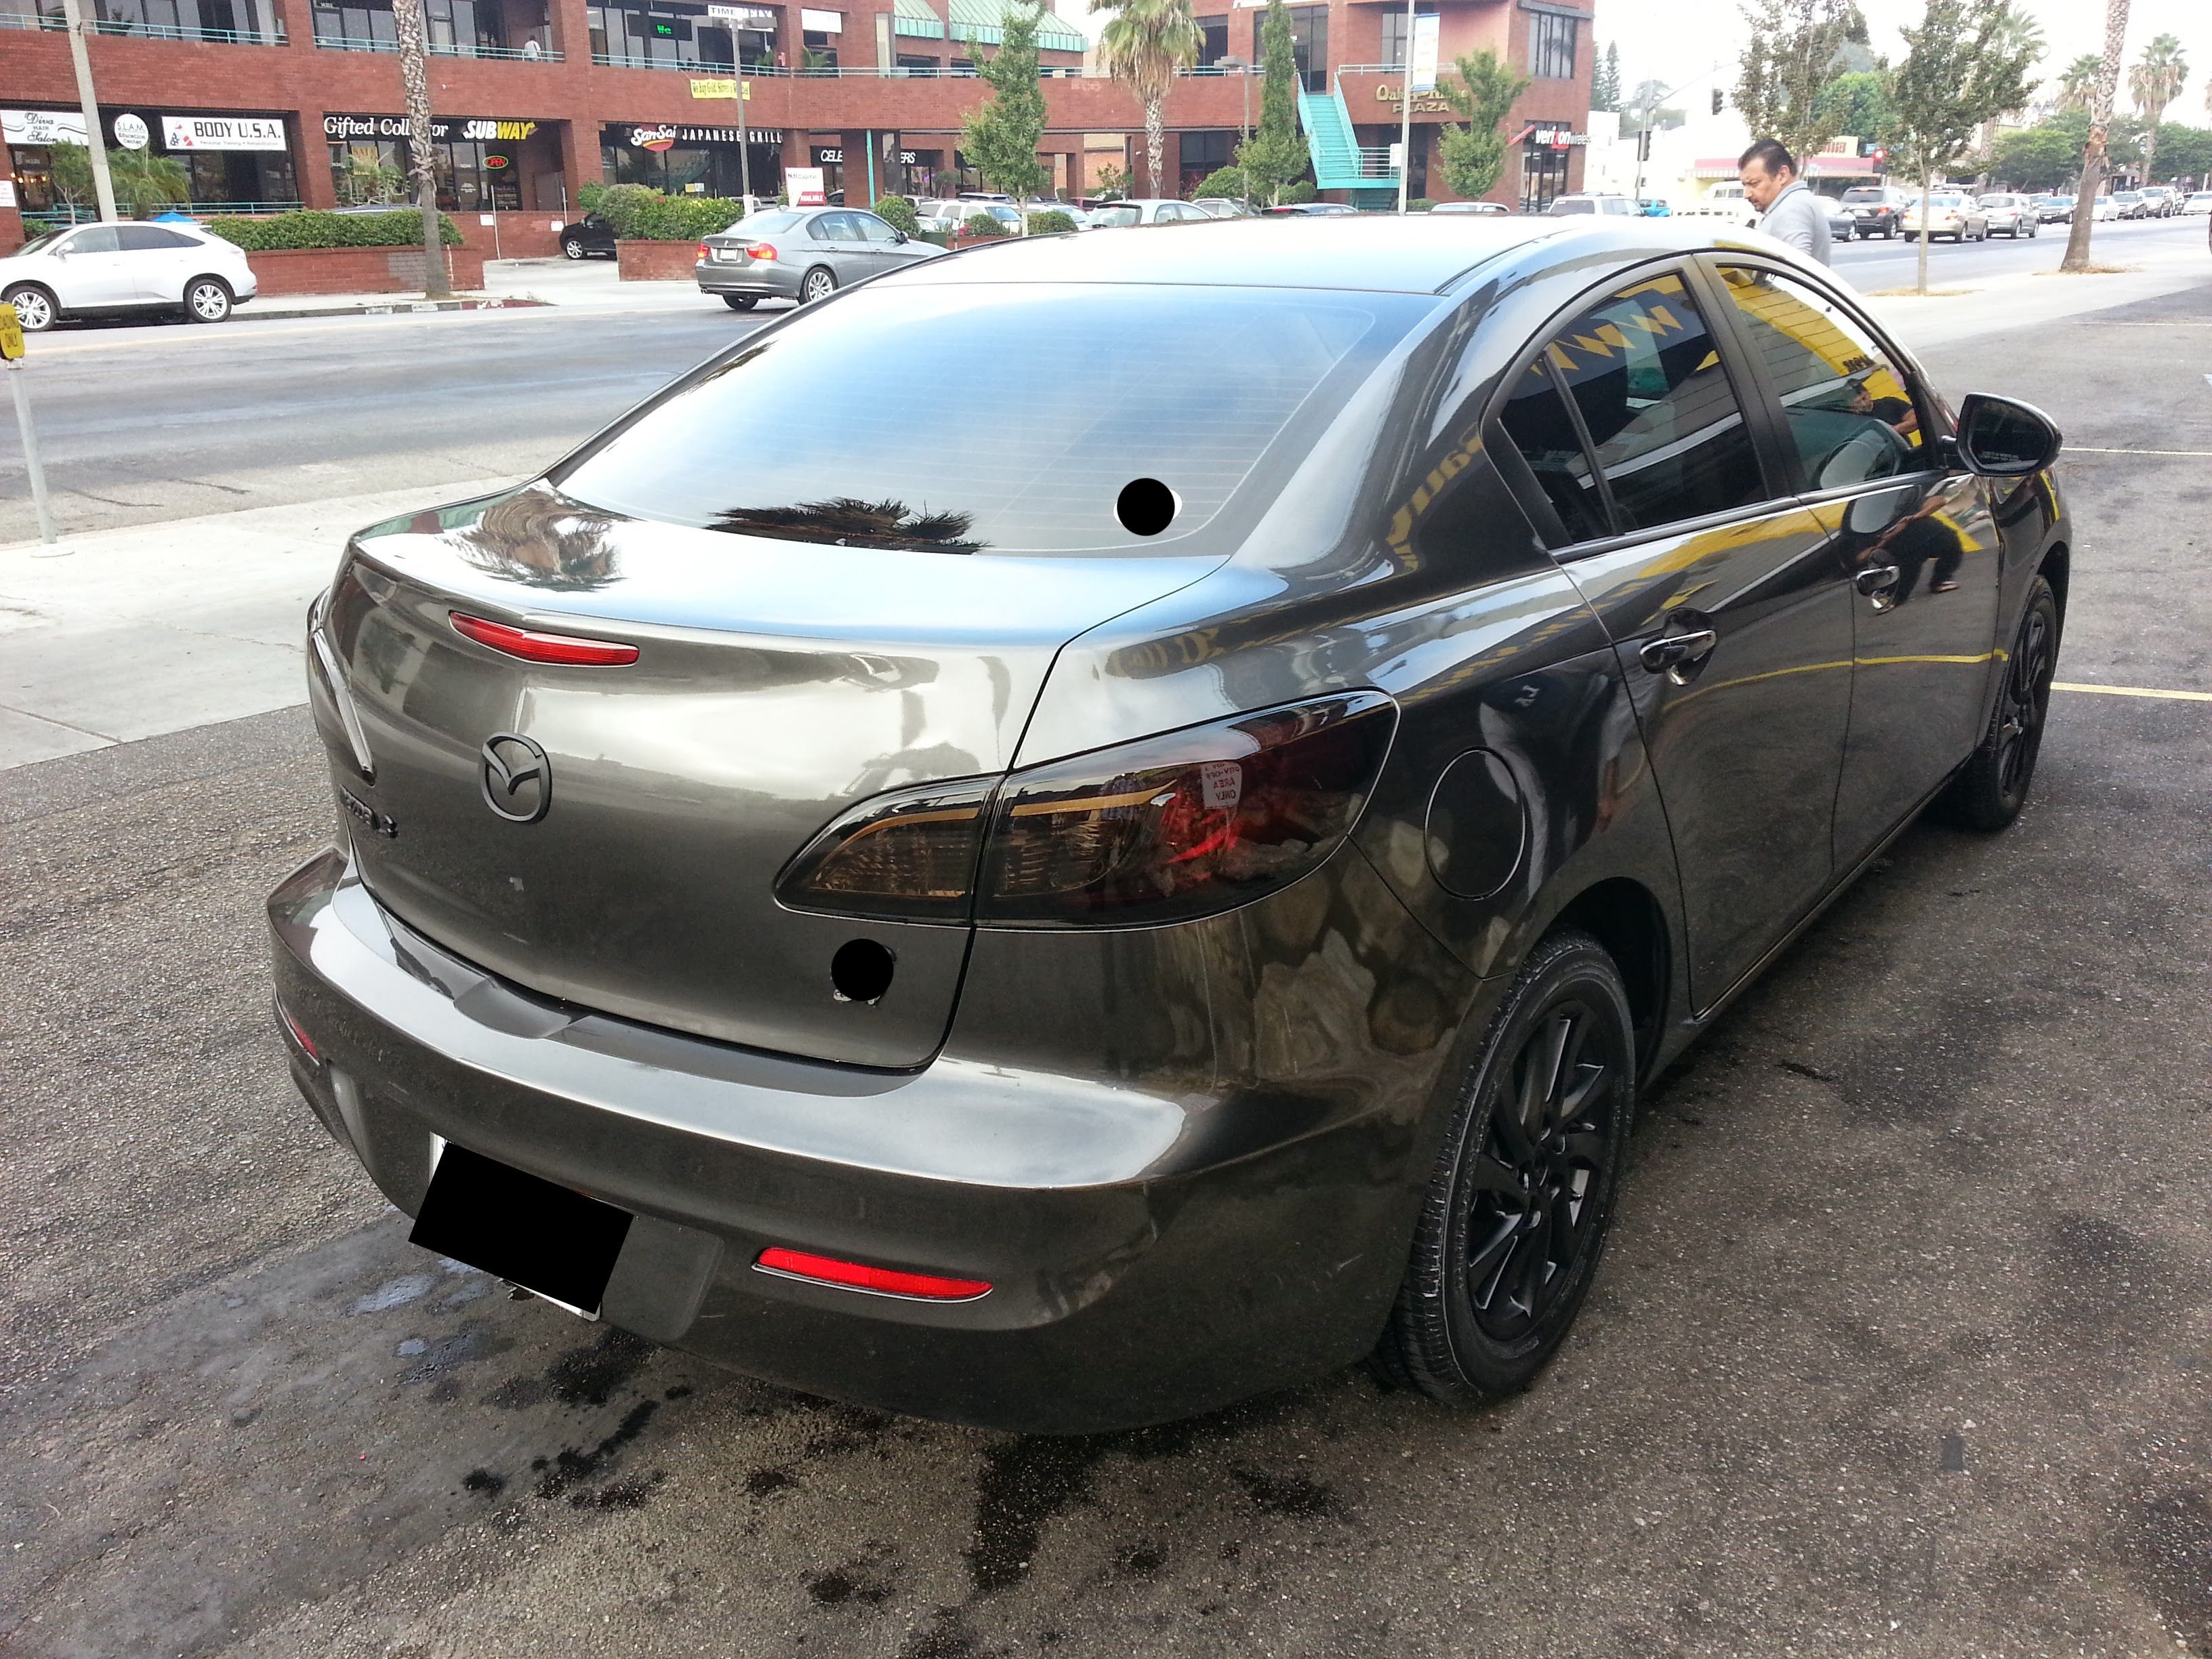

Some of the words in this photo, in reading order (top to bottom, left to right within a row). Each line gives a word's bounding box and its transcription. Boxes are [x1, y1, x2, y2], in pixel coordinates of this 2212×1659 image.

[1392, 103, 1450, 113] PAZA
[24, 112, 54, 125] Diva
[194, 121, 232, 138] BODY
[238, 123, 281, 138] U.S.A.
[324, 117, 374, 138] Gifted
[380, 118, 449, 137] Collor
[463, 120, 535, 140] SUBWAY
[682, 129, 741, 142] JAPANESE
[750, 131, 782, 143] GRILL
[1535, 125, 1571, 149] verizon
